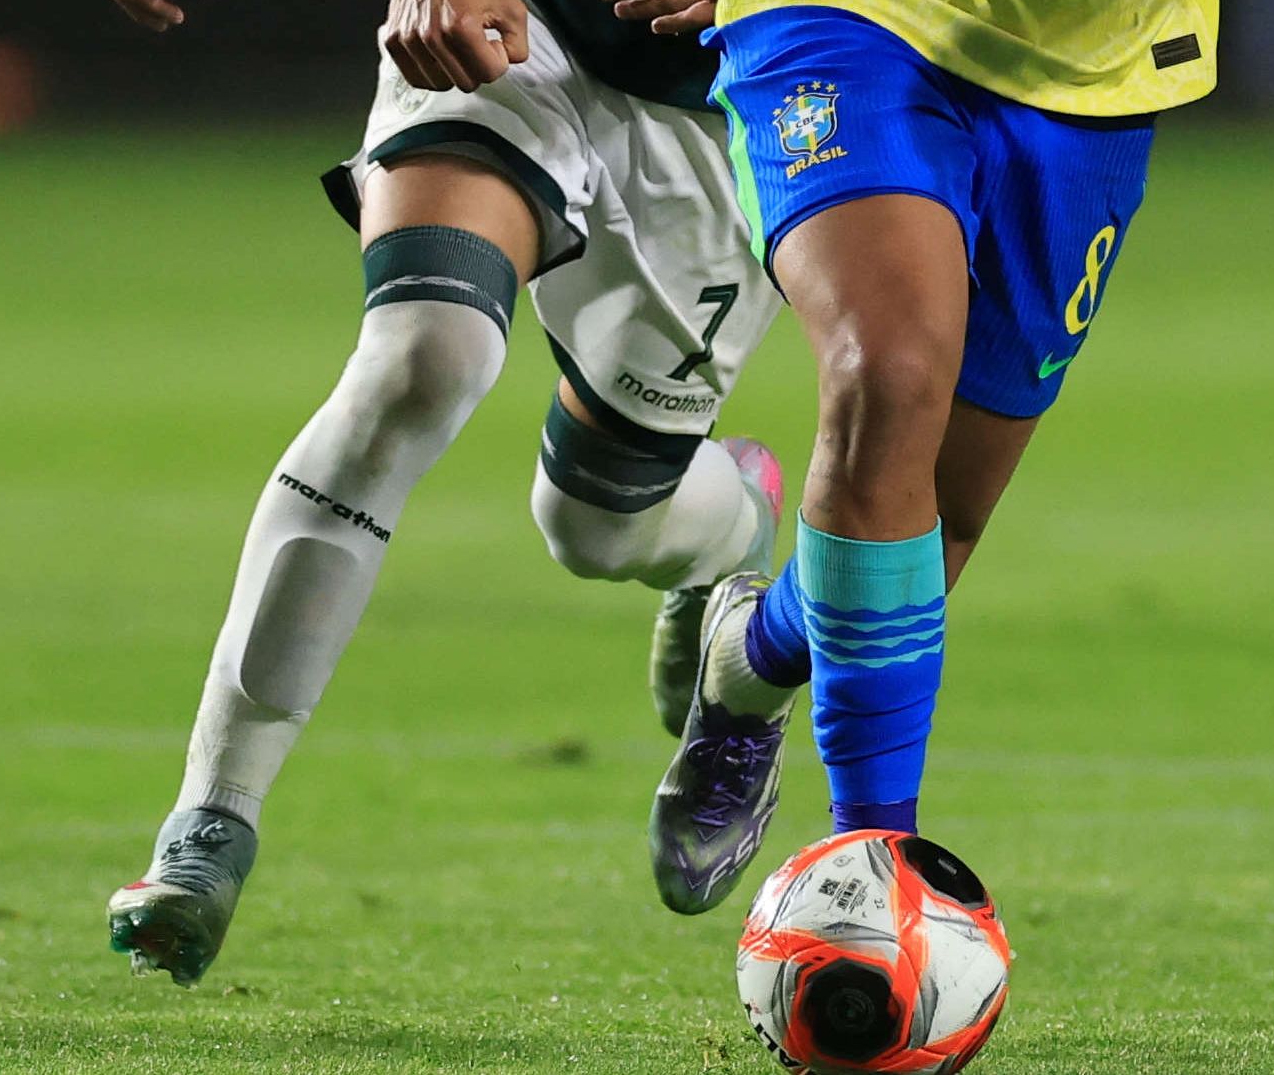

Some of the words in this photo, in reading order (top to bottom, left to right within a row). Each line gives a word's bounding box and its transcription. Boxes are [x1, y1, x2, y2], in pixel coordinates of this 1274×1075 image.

[795, 115, 817, 128] CBF
[785, 145, 848, 180] BRASIL
[1065, 225, 1116, 335] 8
[665, 282, 740, 383] 7
[617, 371, 717, 414] marathon
[277, 472, 391, 544] marathon
